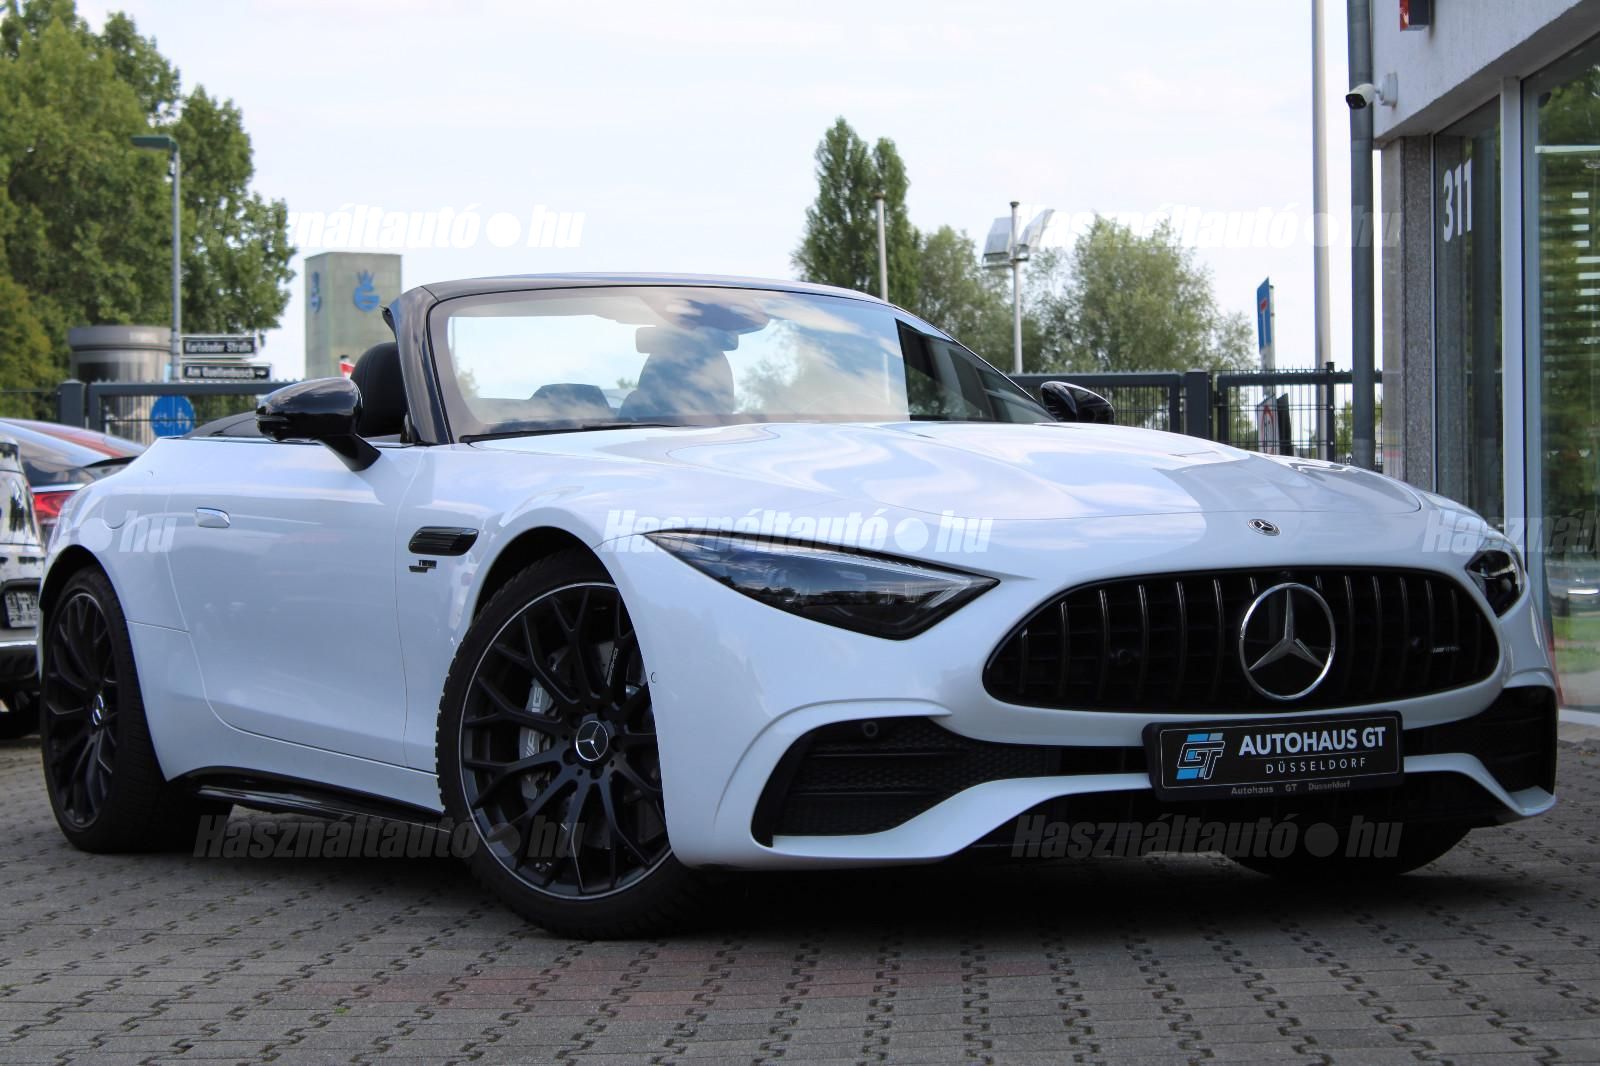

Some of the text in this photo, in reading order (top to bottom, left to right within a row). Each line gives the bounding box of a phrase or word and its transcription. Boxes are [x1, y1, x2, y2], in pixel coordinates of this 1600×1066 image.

[1443, 159, 1472, 242] 311
[1238, 726, 1387, 756] AUTOHAUS GT
[1265, 757, 1367, 774] DÜSSELDORF
[1231, 785, 1274, 796] Autohaus
[1285, 783, 1298, 793] GT
